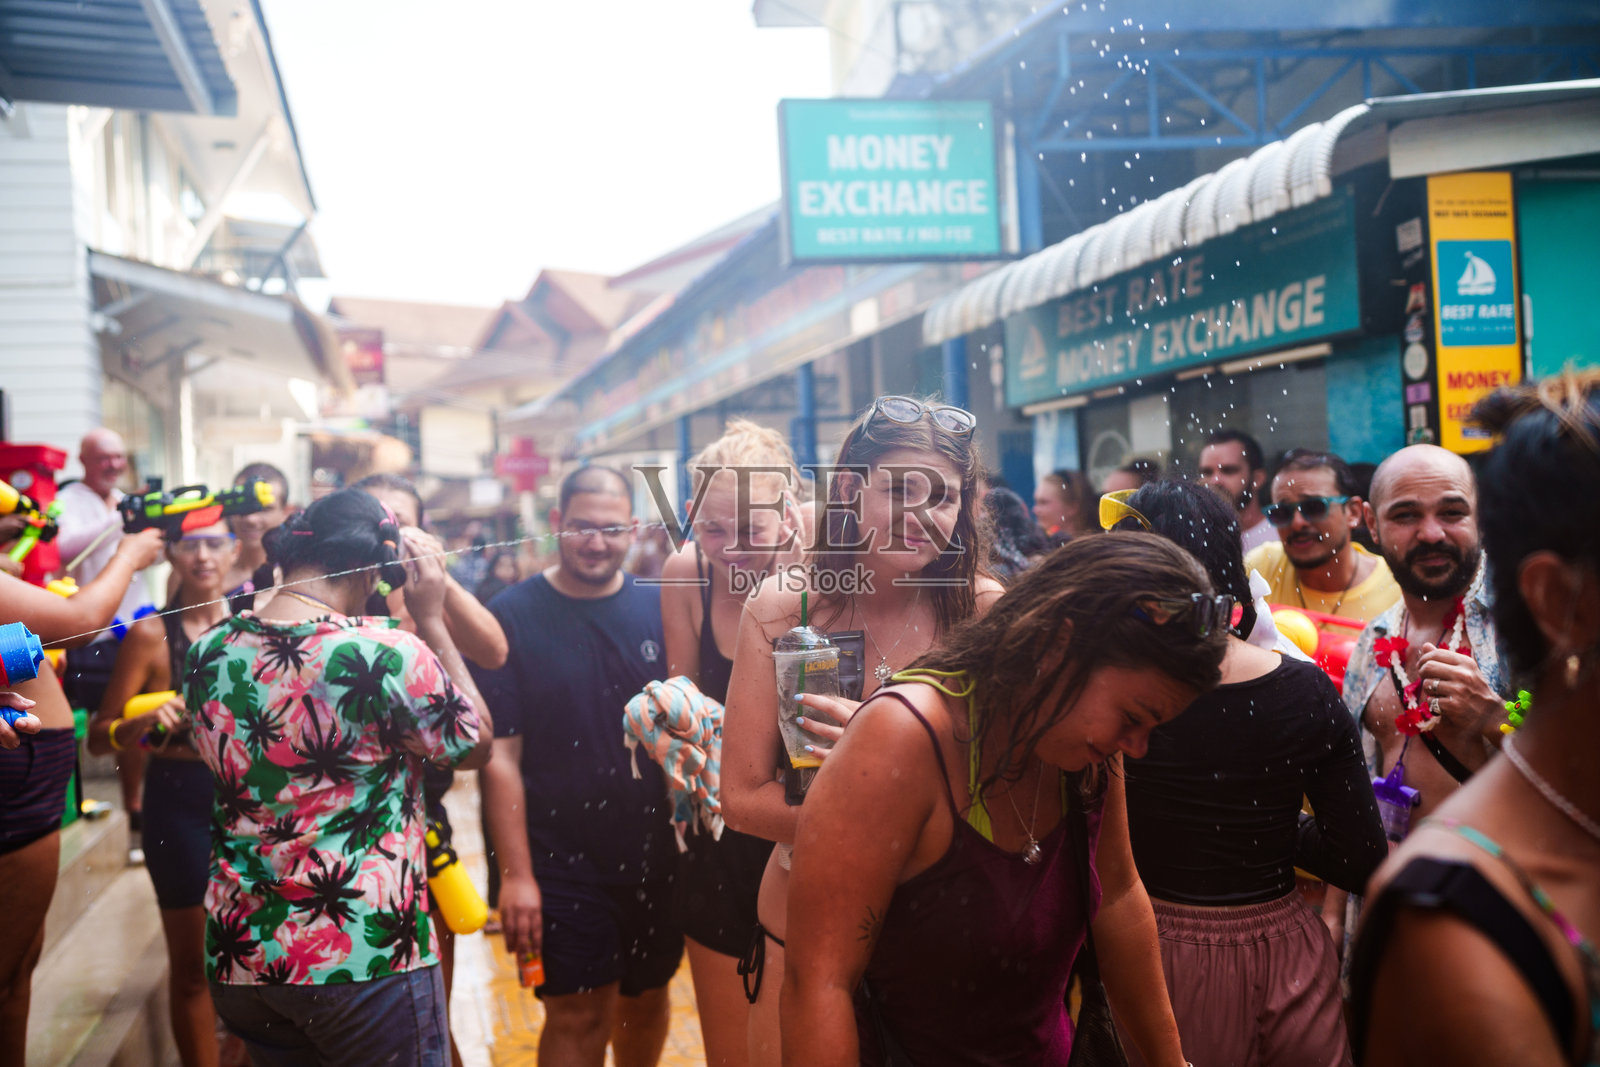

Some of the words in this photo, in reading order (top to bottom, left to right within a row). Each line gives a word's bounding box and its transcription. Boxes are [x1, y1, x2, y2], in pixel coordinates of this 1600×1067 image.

[828, 134, 953, 170] MONEY
[798, 180, 988, 216] EXCHANGE
[817, 228, 857, 244] BEST
[862, 227, 901, 243] RATE
[1057, 287, 1115, 338] BEST
[1127, 256, 1204, 314] RATE
[1442, 305, 1475, 320] BEST
[1478, 304, 1514, 319] RATE
[1057, 328, 1143, 386] MONEY
[1152, 275, 1326, 364] EXCHANGE
[1447, 370, 1511, 389] MONEY
